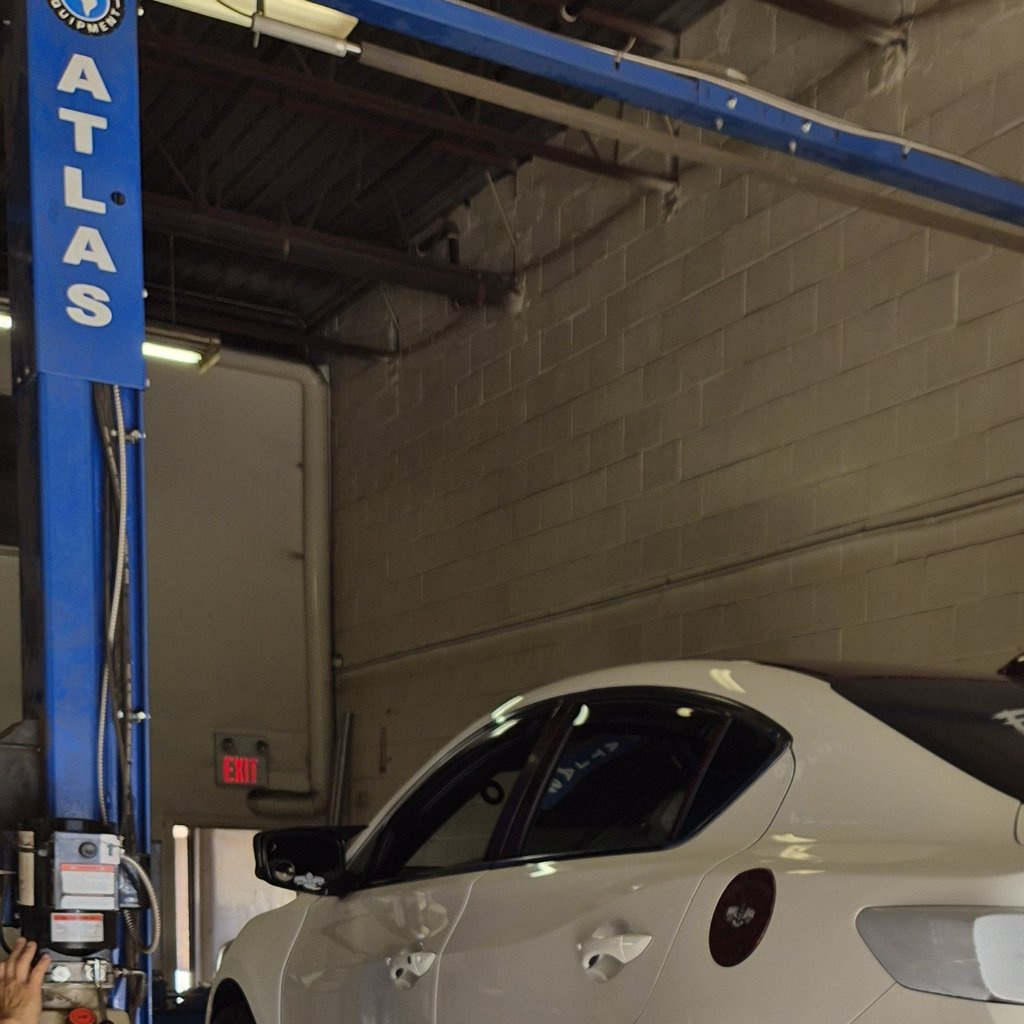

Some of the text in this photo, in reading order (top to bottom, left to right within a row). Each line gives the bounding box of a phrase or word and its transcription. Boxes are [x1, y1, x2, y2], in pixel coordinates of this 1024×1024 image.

[50, 0, 121, 33] QUIPMENT
[56, 53, 117, 327] ATLAS
[223, 755, 258, 784] EXIT
